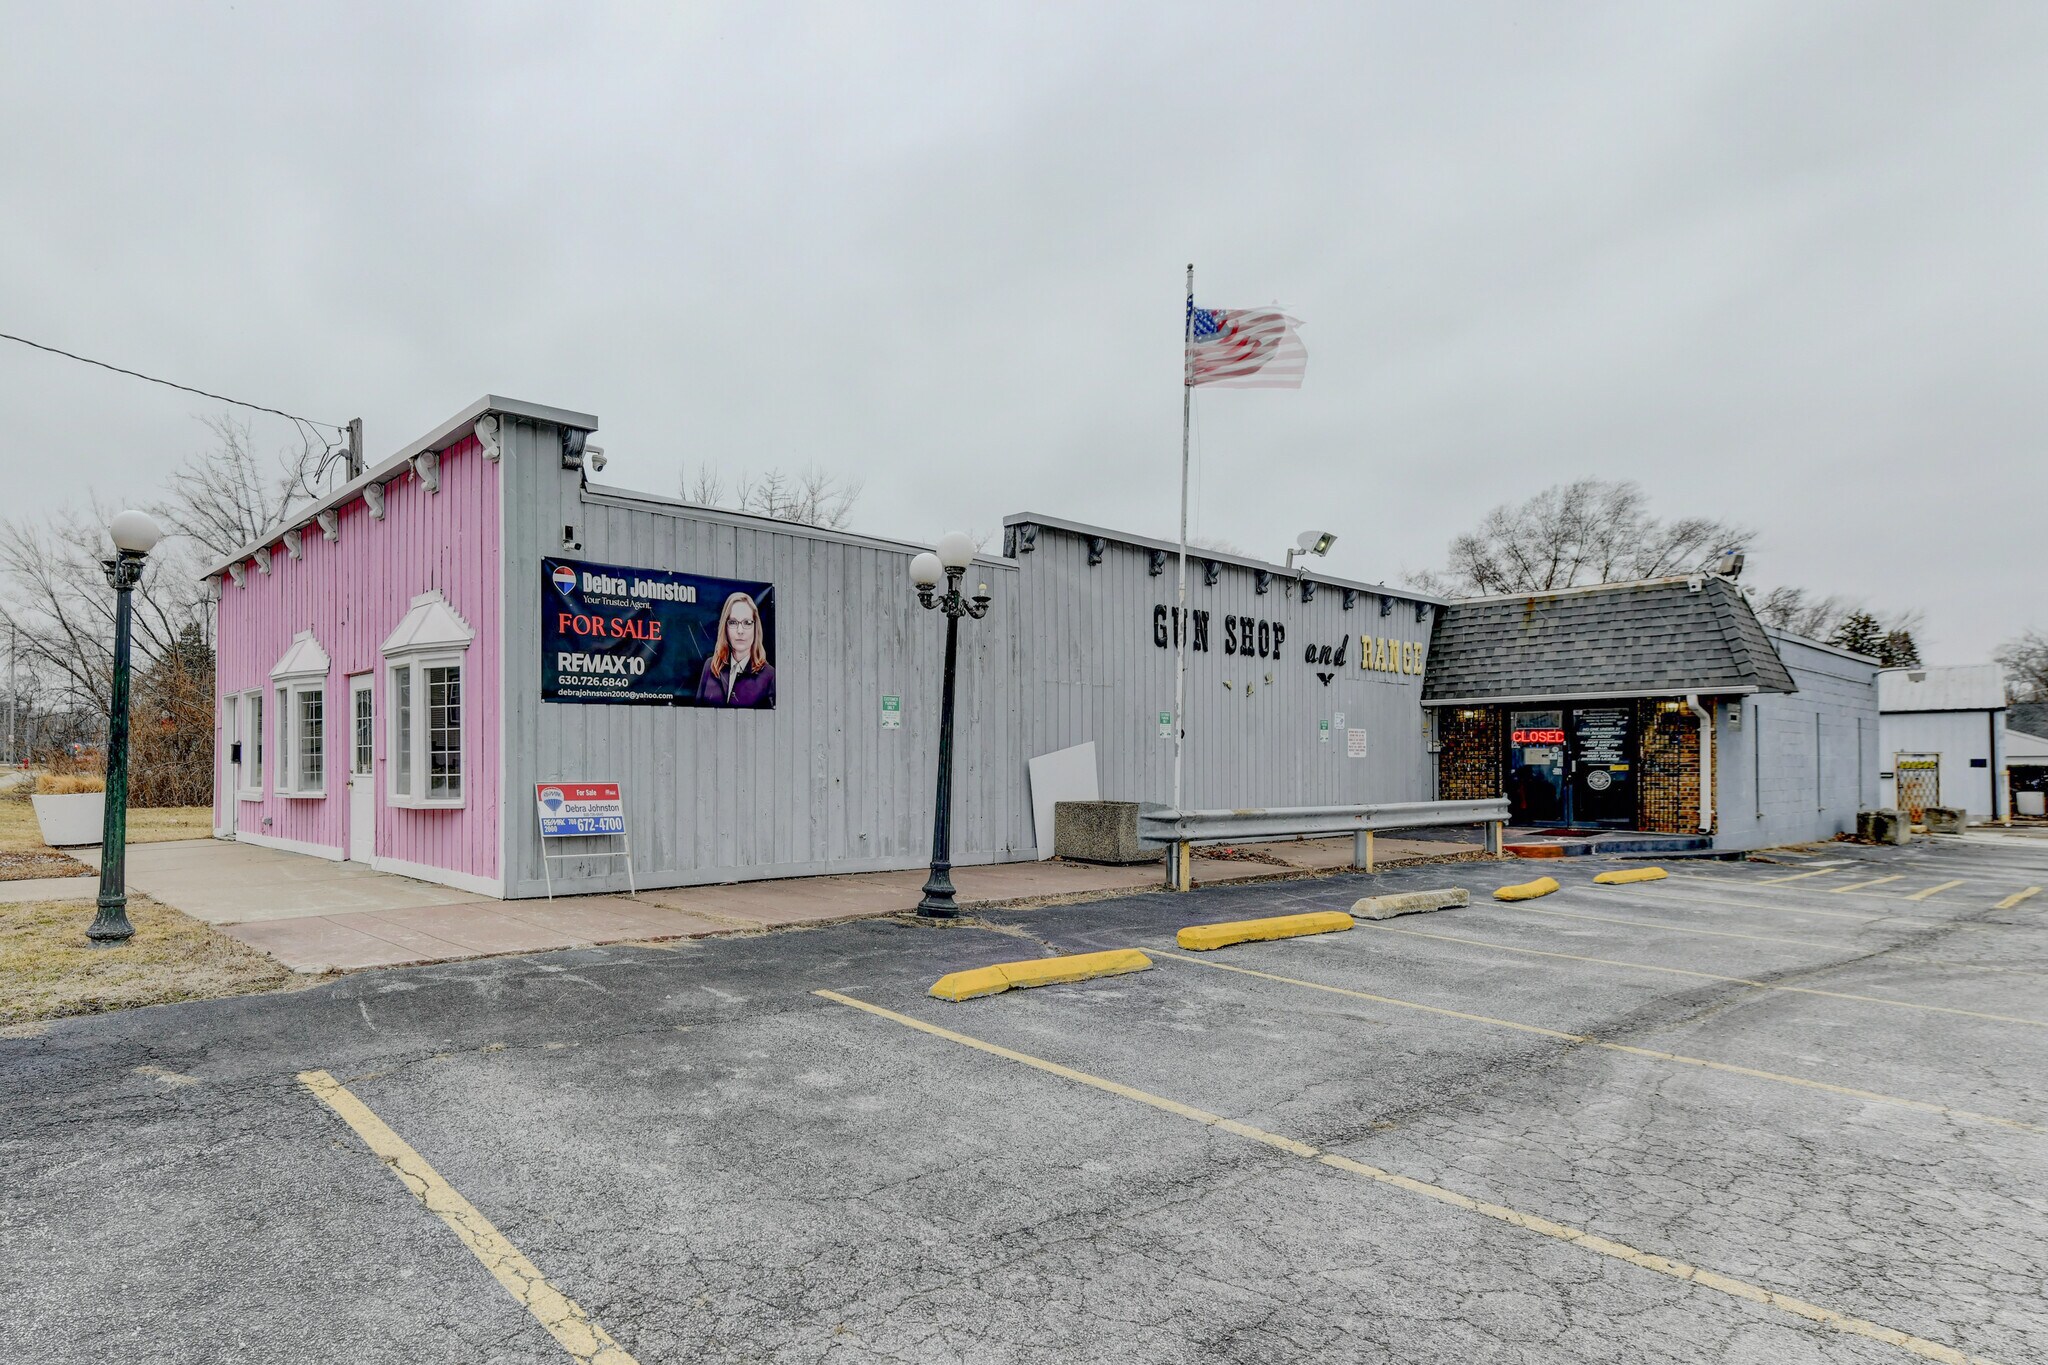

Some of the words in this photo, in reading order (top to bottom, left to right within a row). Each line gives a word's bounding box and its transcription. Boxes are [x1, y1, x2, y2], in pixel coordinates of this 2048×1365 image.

[582, 572, 627, 596] Debra
[630, 577, 697, 604] Johnston
[583, 595, 601, 604] Your
[602, 596, 629, 607] Trusted
[558, 613, 606, 637] FOR
[610, 617, 662, 641] SALE
[1153, 604, 1210, 652] GUN
[1225, 614, 1286, 660] SHOP
[1305, 634, 1350, 667] and
[1360, 634, 1423, 676] RANGE
[627, 656, 645, 675] 10
[558, 675, 629, 687] 630.726.6840
[558, 688, 674, 699] debrajohnston2000@yahoo.com
[1512, 730, 1565, 743] CLOSED
[565, 804, 587, 813] Debra
[588, 803, 620, 813] Johnston
[544, 825, 558, 833] 2000
[577, 817, 622, 832] 672-4700
